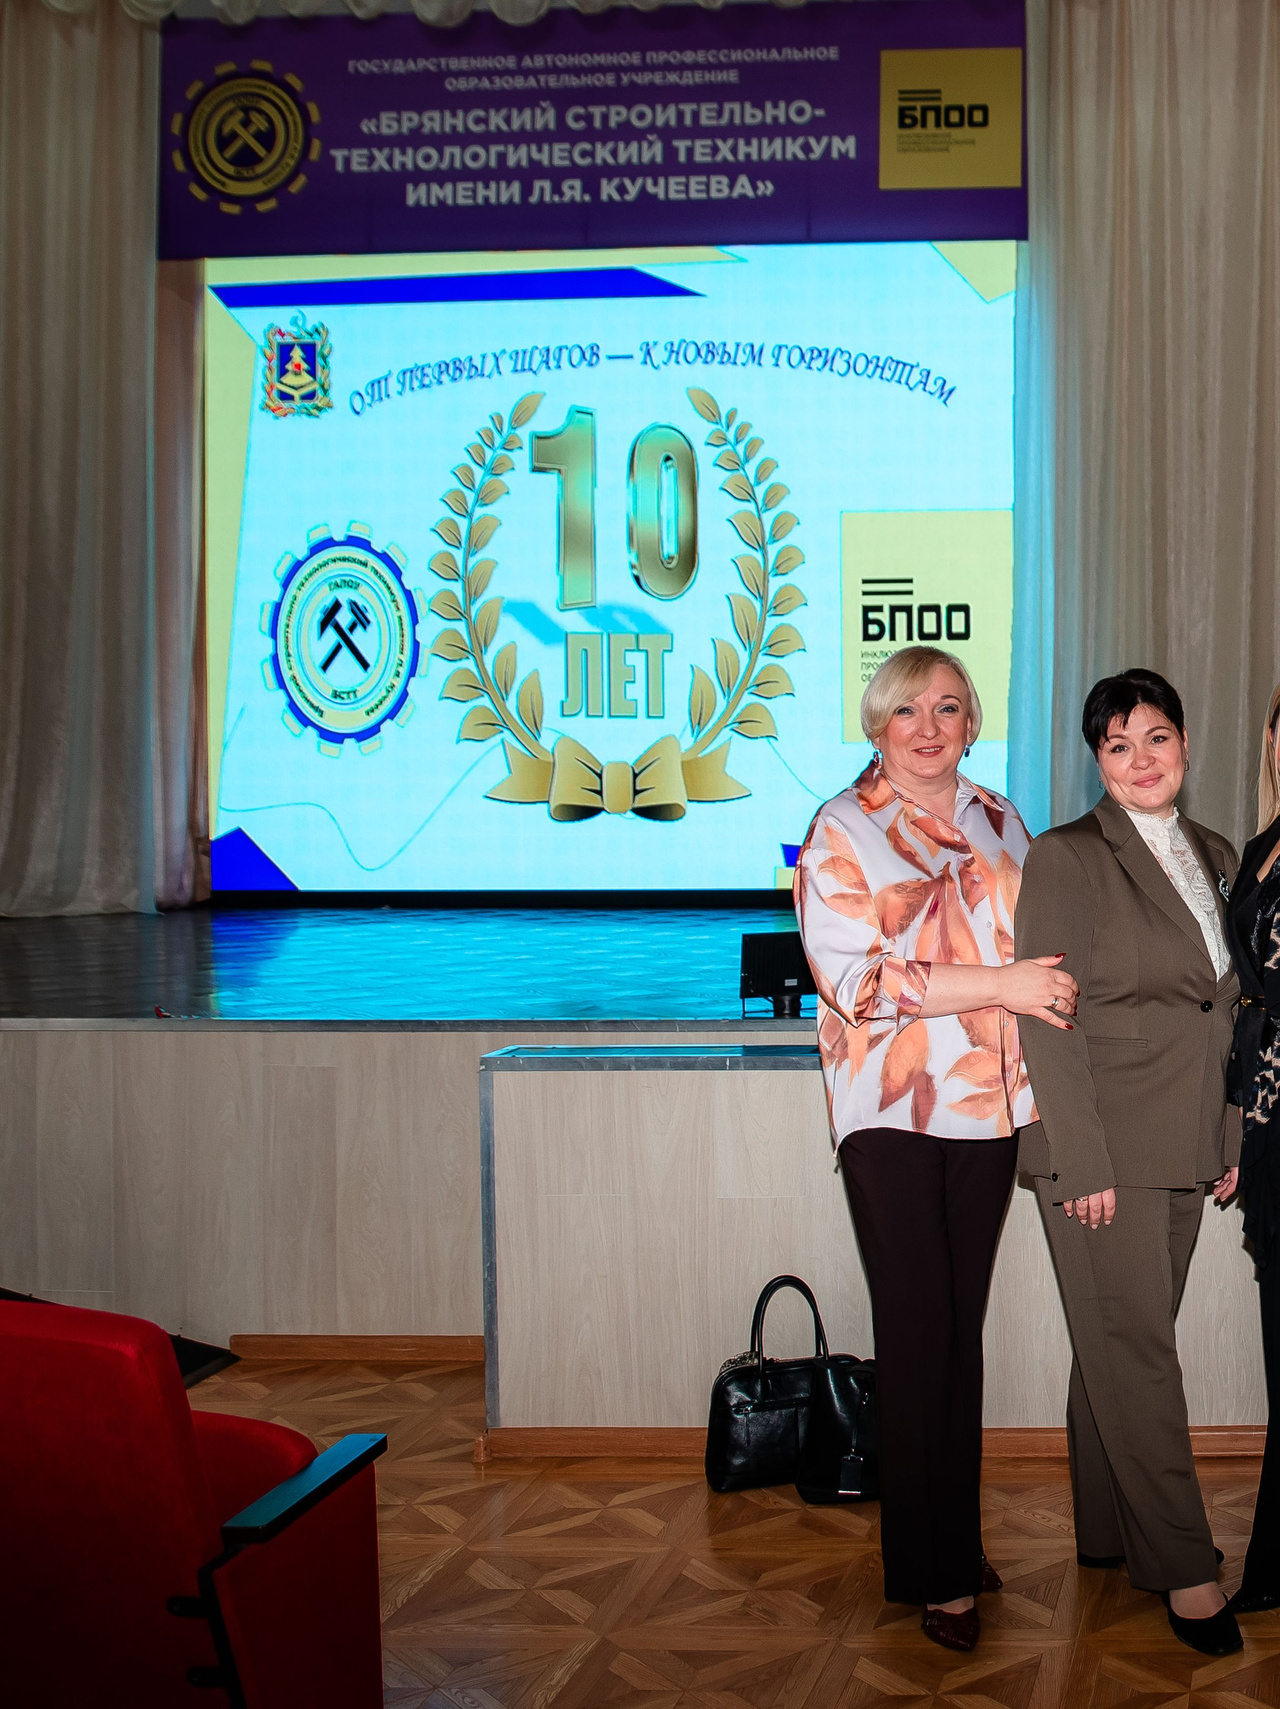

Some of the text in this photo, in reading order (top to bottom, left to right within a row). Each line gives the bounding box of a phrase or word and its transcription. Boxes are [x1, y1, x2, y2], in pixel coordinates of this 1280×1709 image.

[348, 46, 839, 75] ГОСУДАРСТВЕННОЕ АВТОНОМНОЕ ПРОФЕССИОНАЛЬНОЕ
[444, 69, 740, 92] ОБРАЗОВАТЕЛЬНОЕ УЧРЕЖДЕНИЕ
[360, 99, 826, 136] «БРЯНСКИЙ СТРОИТЕЛЬНО-
[898, 104, 989, 129] БПОО
[330, 134, 857, 173] ТЕХНОЛОГИЧЕСКИЙ ТЕХНИКУМ
[405, 174, 775, 207] ИМЕНИ Л.Я. КУЧЕЕВА»
[349, 369, 392, 416] ОТ
[396, 348, 507, 397] ПЕРВЫХ
[639, 340, 660, 370] К
[662, 338, 766, 368] НОВЫМ
[771, 342, 957, 407] ГОРИЗОНТАМ
[529, 405, 699, 610] 10
[862, 604, 970, 641] БПОО
[561, 631, 674, 719] ЛЕТ
